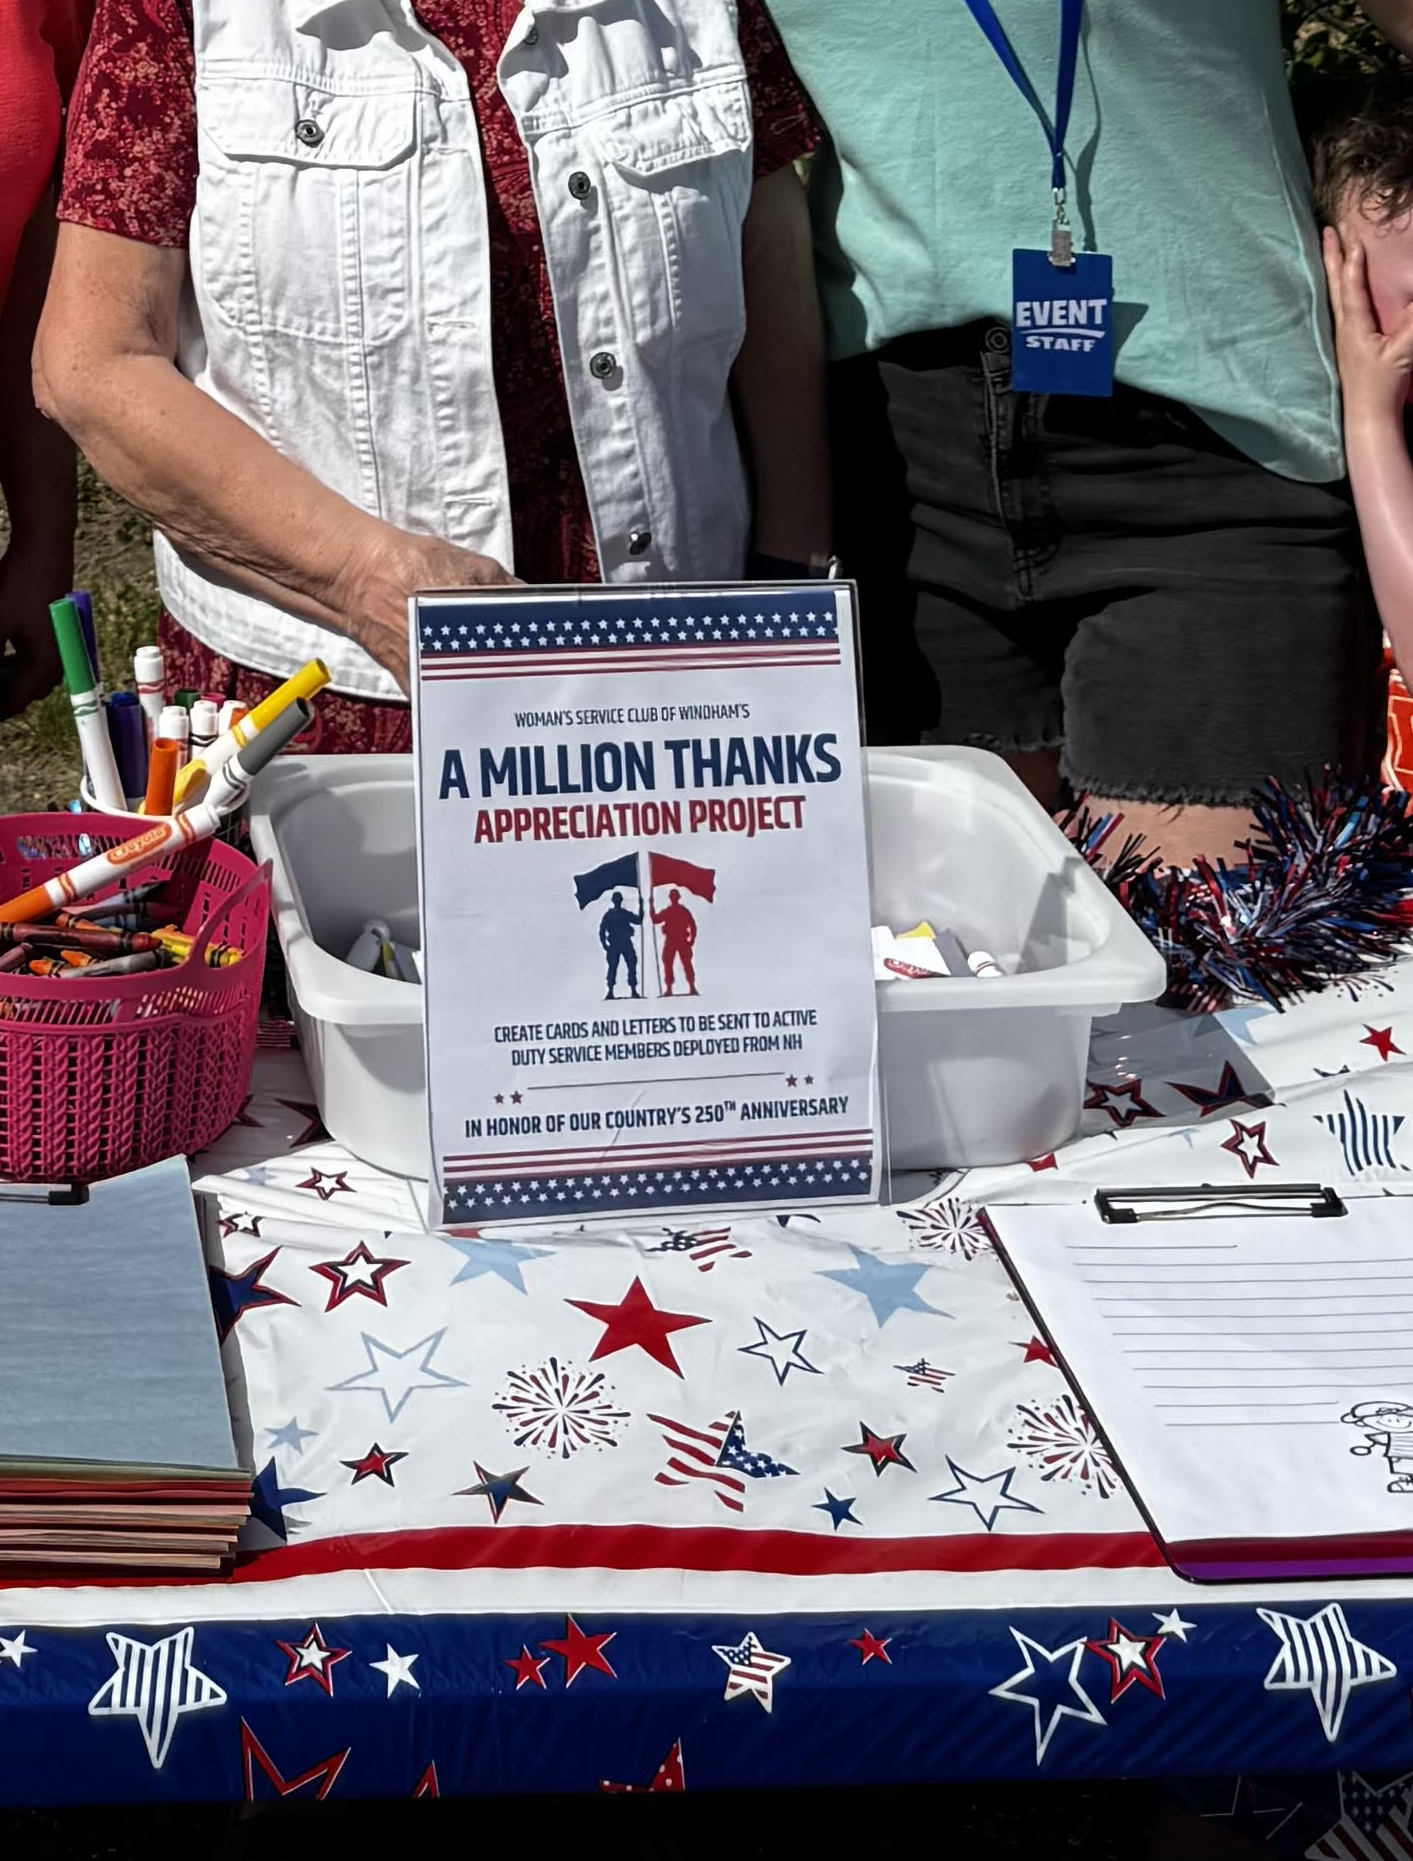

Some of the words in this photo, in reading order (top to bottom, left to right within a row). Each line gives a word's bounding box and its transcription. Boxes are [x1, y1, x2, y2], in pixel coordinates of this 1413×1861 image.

[1015, 299, 1107, 327] EVENT
[1025, 336, 1095, 352] STAFF
[514, 710, 574, 728] WOMAN'S
[575, 708, 625, 725] SERVICE
[627, 707, 658, 723] CLUB
[661, 706, 676, 721] OF
[679, 703, 751, 721] WINDHAM'S
[439, 748, 470, 799] A
[479, 741, 655, 798] MILLION
[664, 733, 842, 790] THANKS
[474, 800, 681, 844] APPRECIATION
[689, 795, 807, 838] PROJECT
[494, 1023, 543, 1043] CREATE
[545, 1019, 589, 1040] CARDS
[591, 1018, 620, 1038] AND
[622, 1015, 676, 1036] LETTERS
[679, 1014, 696, 1032] TO
[698, 1013, 715, 1031] BE
[717, 1011, 754, 1030] SENT
[754, 1011, 771, 1029] TO
[773, 1009, 818, 1027] ACTIVE
[511, 1046, 547, 1066] DUTY
[548, 1043, 603, 1065] SERVICE
[604, 1040, 671, 1061] MEMBERS
[673, 1037, 741, 1057] DEPLOYED
[743, 1035, 780, 1053] FROM
[783, 1033, 803, 1051] NH
[465, 1119, 483, 1138] IN
[486, 1114, 542, 1136] HONOR
[545, 1113, 566, 1132] OF
[569, 1110, 602, 1131] OUR
[605, 1106, 691, 1129] COUNTRY'S
[740, 1095, 850, 1121] ANNIVERSARY
